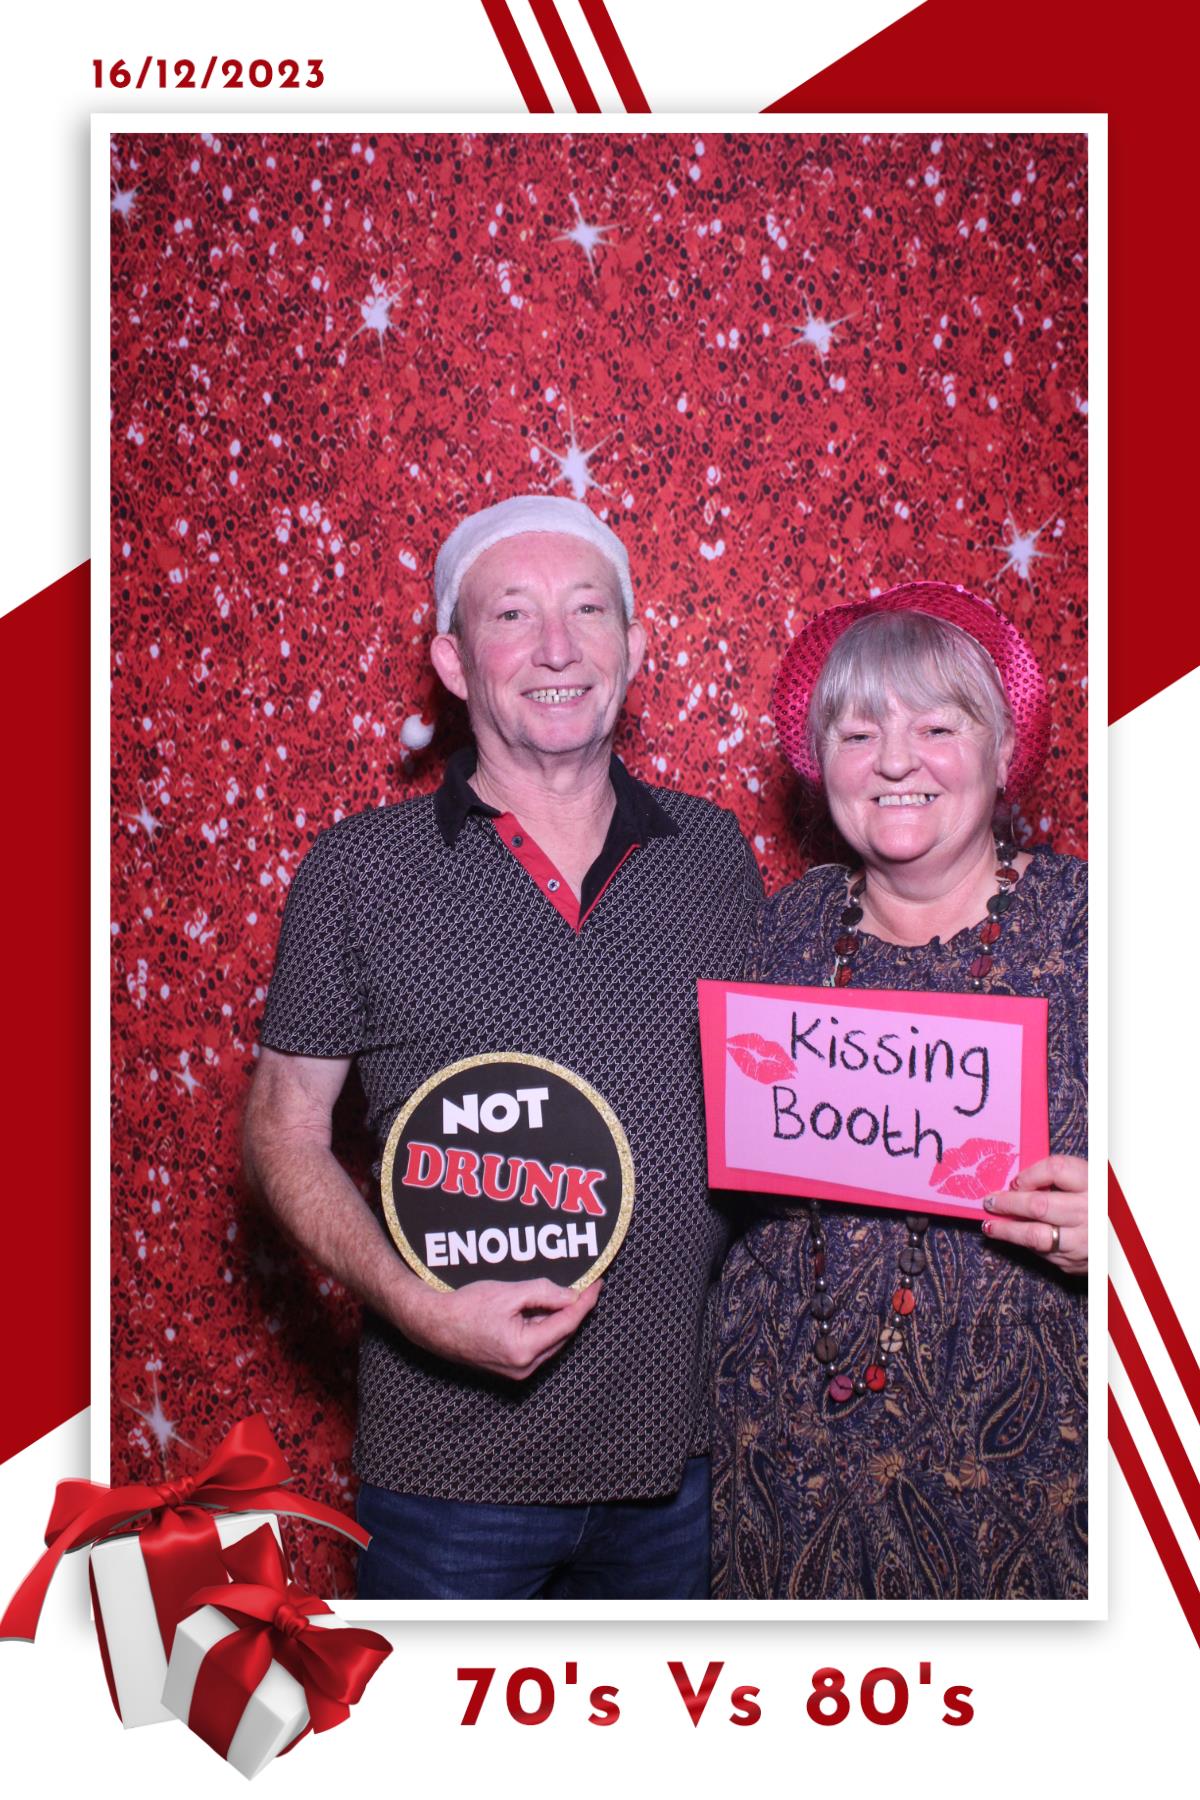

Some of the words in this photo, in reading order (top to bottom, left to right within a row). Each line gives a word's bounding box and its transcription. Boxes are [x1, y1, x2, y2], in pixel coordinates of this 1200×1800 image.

[790, 1011, 990, 1117] Kissing
[442, 1087, 549, 1135] NOT
[772, 1085, 944, 1164] Booth
[401, 1141, 607, 1217] DRUNK
[424, 1221, 599, 1268] ENOUGH
